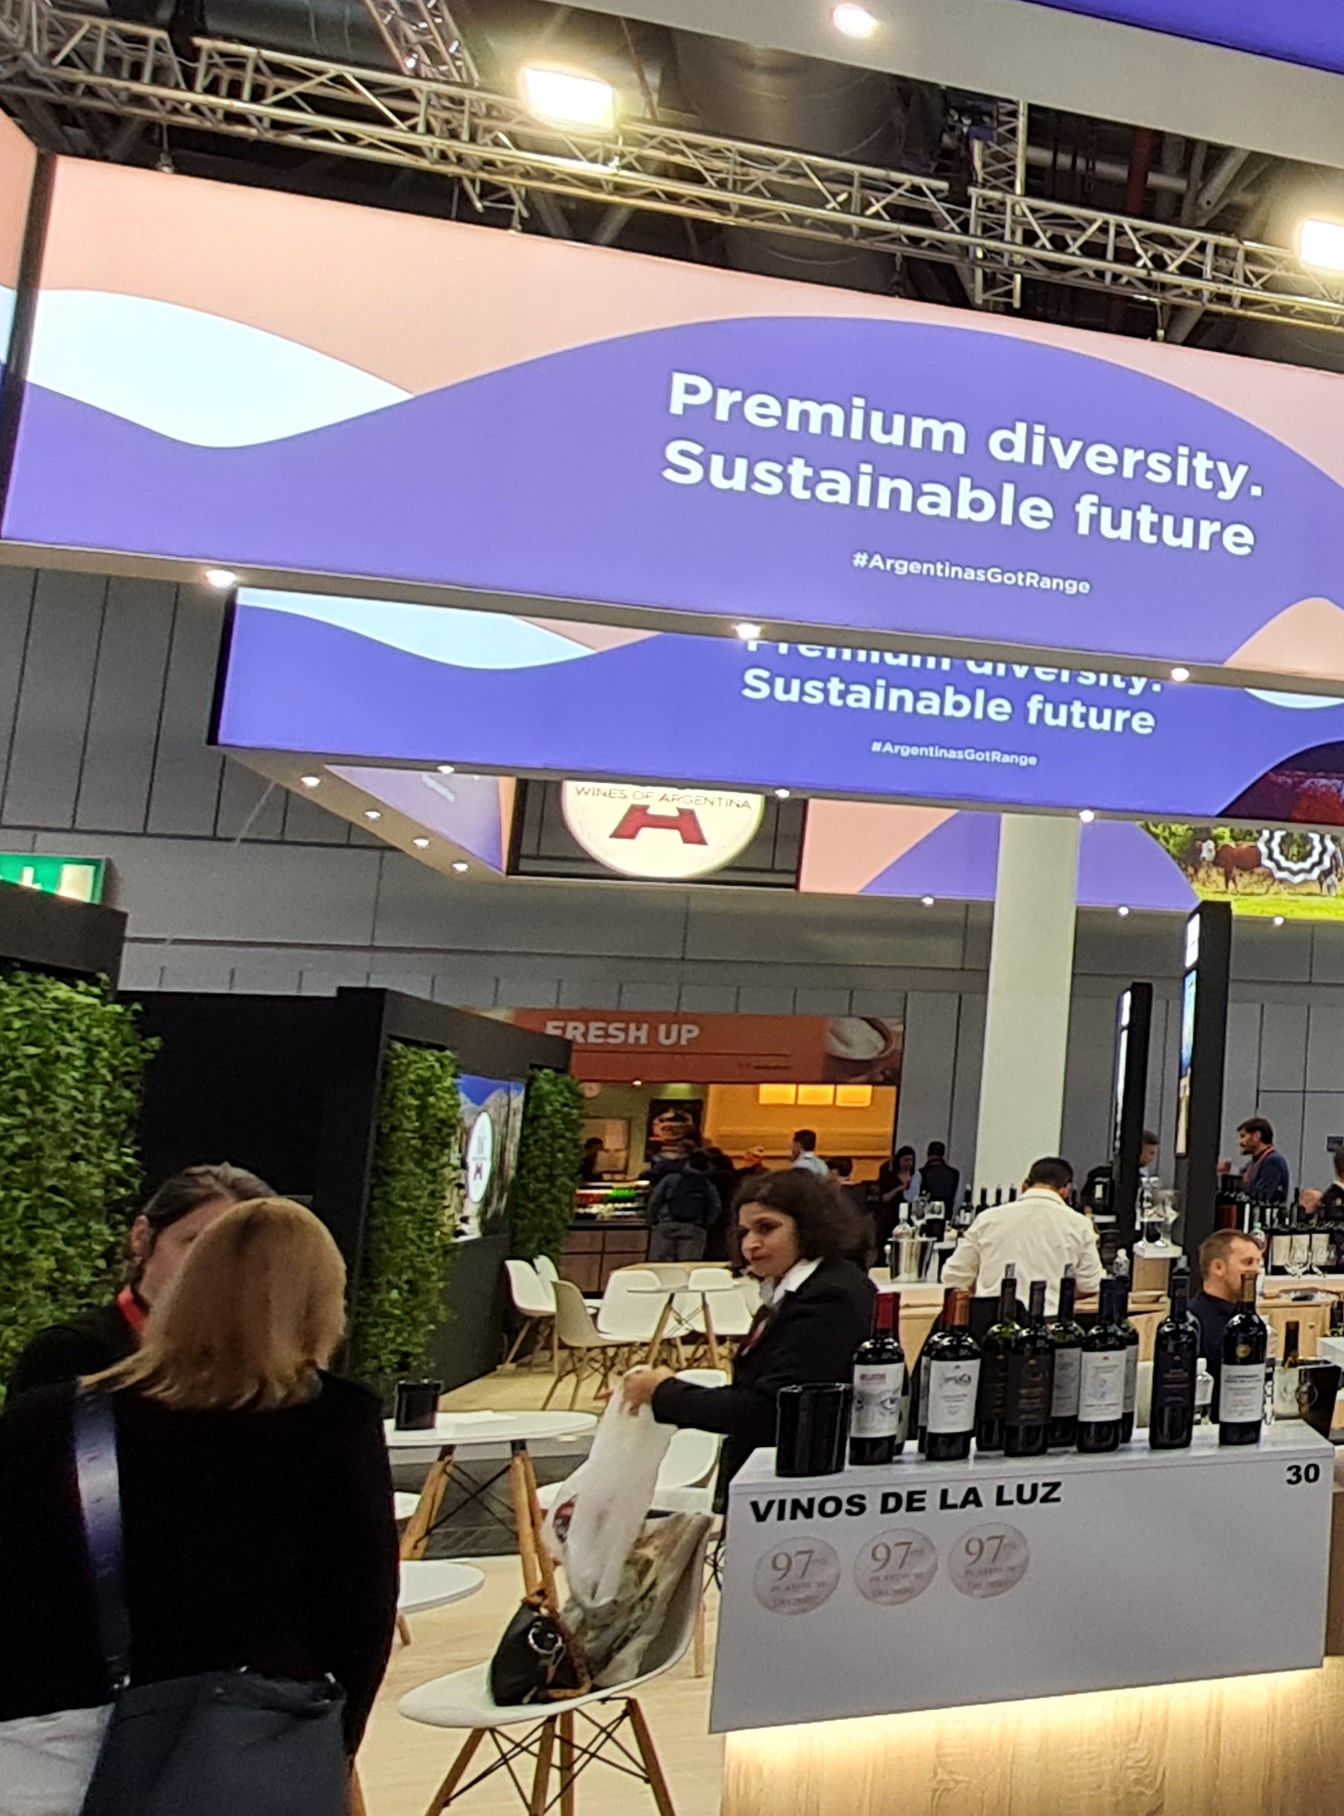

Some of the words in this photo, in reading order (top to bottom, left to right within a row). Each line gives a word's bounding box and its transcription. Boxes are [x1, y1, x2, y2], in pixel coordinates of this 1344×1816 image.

[667, 371, 966, 456] Premium
[987, 421, 1263, 499] diversity.
[661, 441, 1054, 531] Sustainable
[1074, 494, 1256, 556] future
[852, 551, 1091, 596] #ArgentinasGotRange
[741, 668, 1013, 722] Sustainable
[1025, 694, 1156, 735] future
[871, 741, 1038, 767] #ArgentinasGotRange
[575, 786, 628, 800] WINES
[632, 790, 651, 800] OF
[659, 794, 751, 808] ARGENTINA
[546, 1020, 649, 1046] FRESH
[658, 1023, 700, 1046] UP
[1285, 1463, 1321, 1487] 30
[750, 1492, 868, 1524] VINOS
[879, 1488, 927, 1516] DE
[939, 1485, 983, 1512] LA
[994, 1481, 1063, 1508] LUZ
[771, 1549, 815, 1582] 97
[870, 1541, 913, 1573] 97
[964, 1535, 1006, 1567] 97
